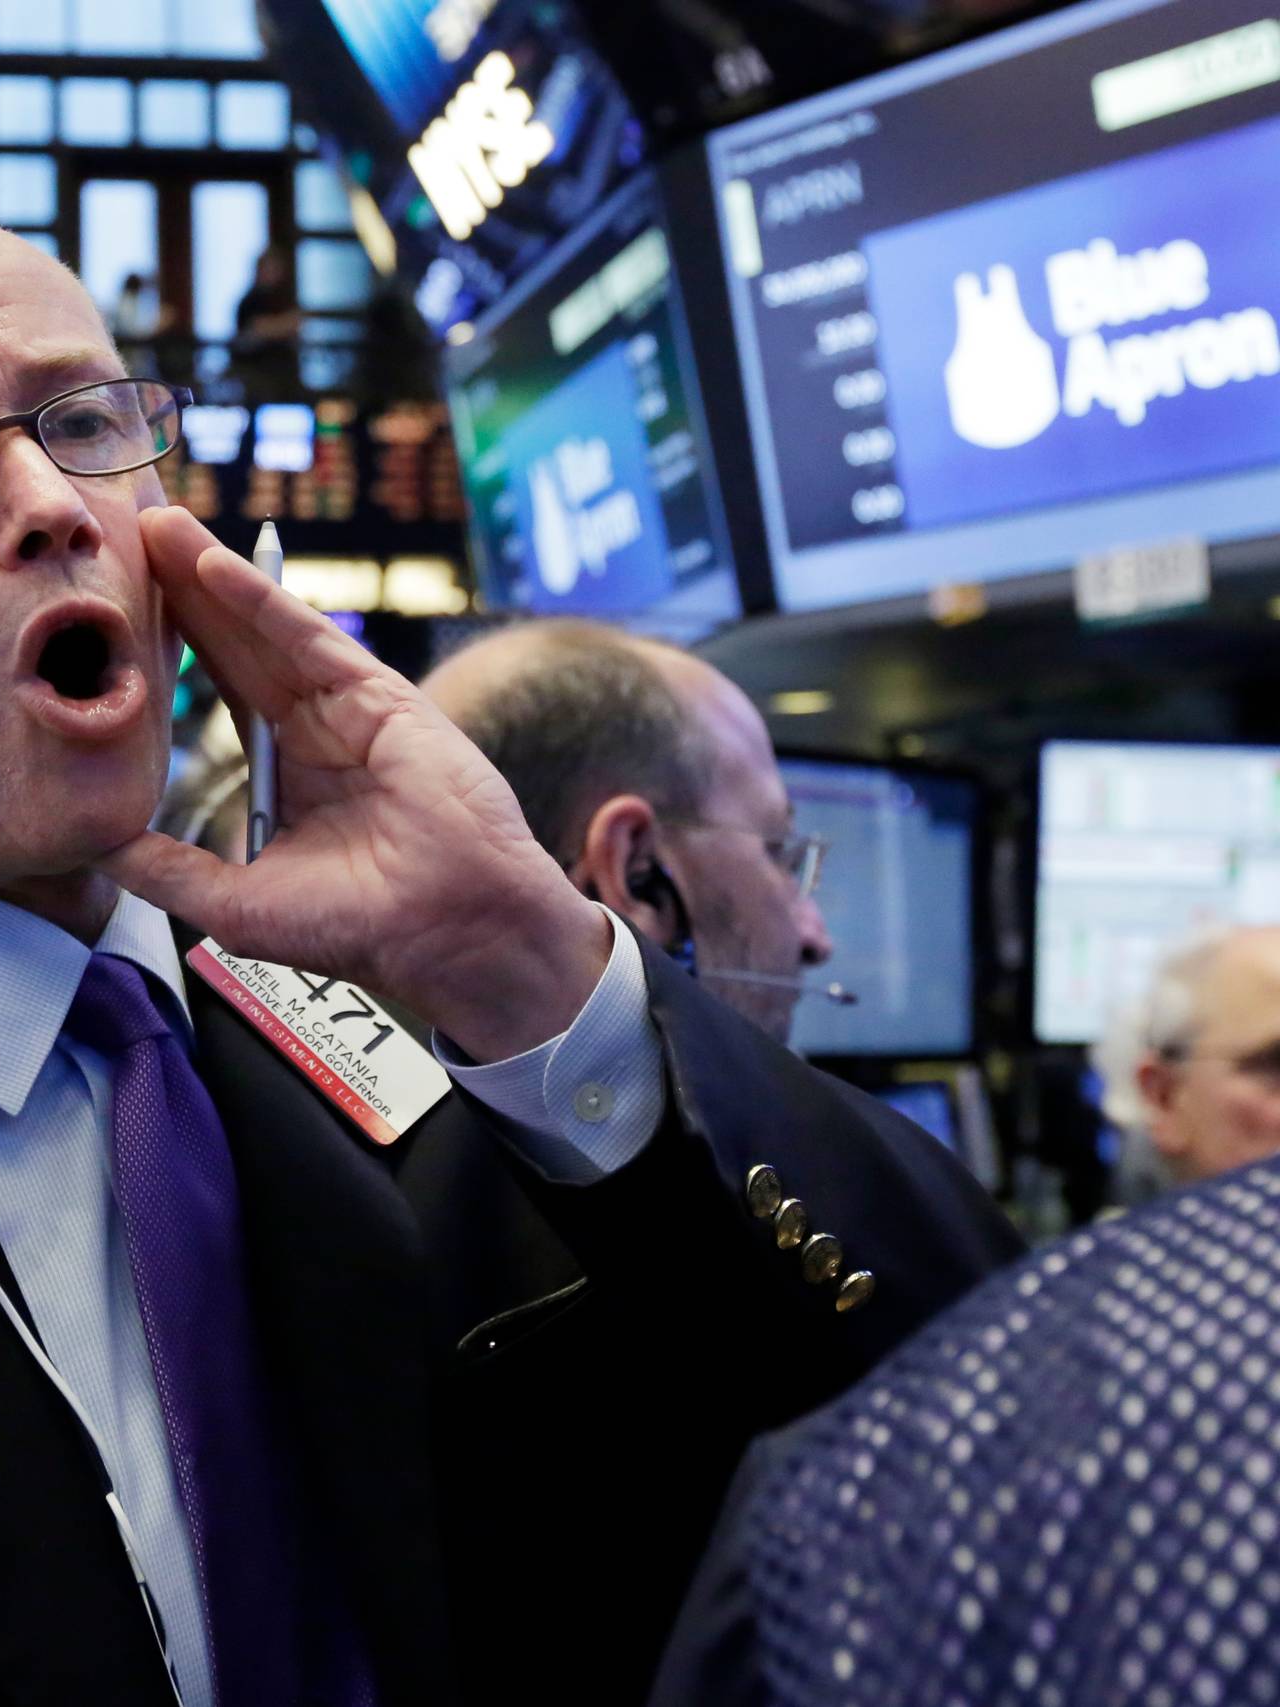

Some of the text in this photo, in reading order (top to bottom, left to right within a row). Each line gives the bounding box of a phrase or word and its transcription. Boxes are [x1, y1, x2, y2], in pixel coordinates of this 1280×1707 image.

[1044, 237, 1210, 337] Blue
[1063, 306, 1280, 428] Apron
[216, 949, 392, 1118] EXECUTIVE FLOOR GOVERNOR
[248, 961, 379, 1088] NEIL M. CATANIA
[291, 967, 395, 1055] 471
[335, 1087, 366, 1115] LLC
